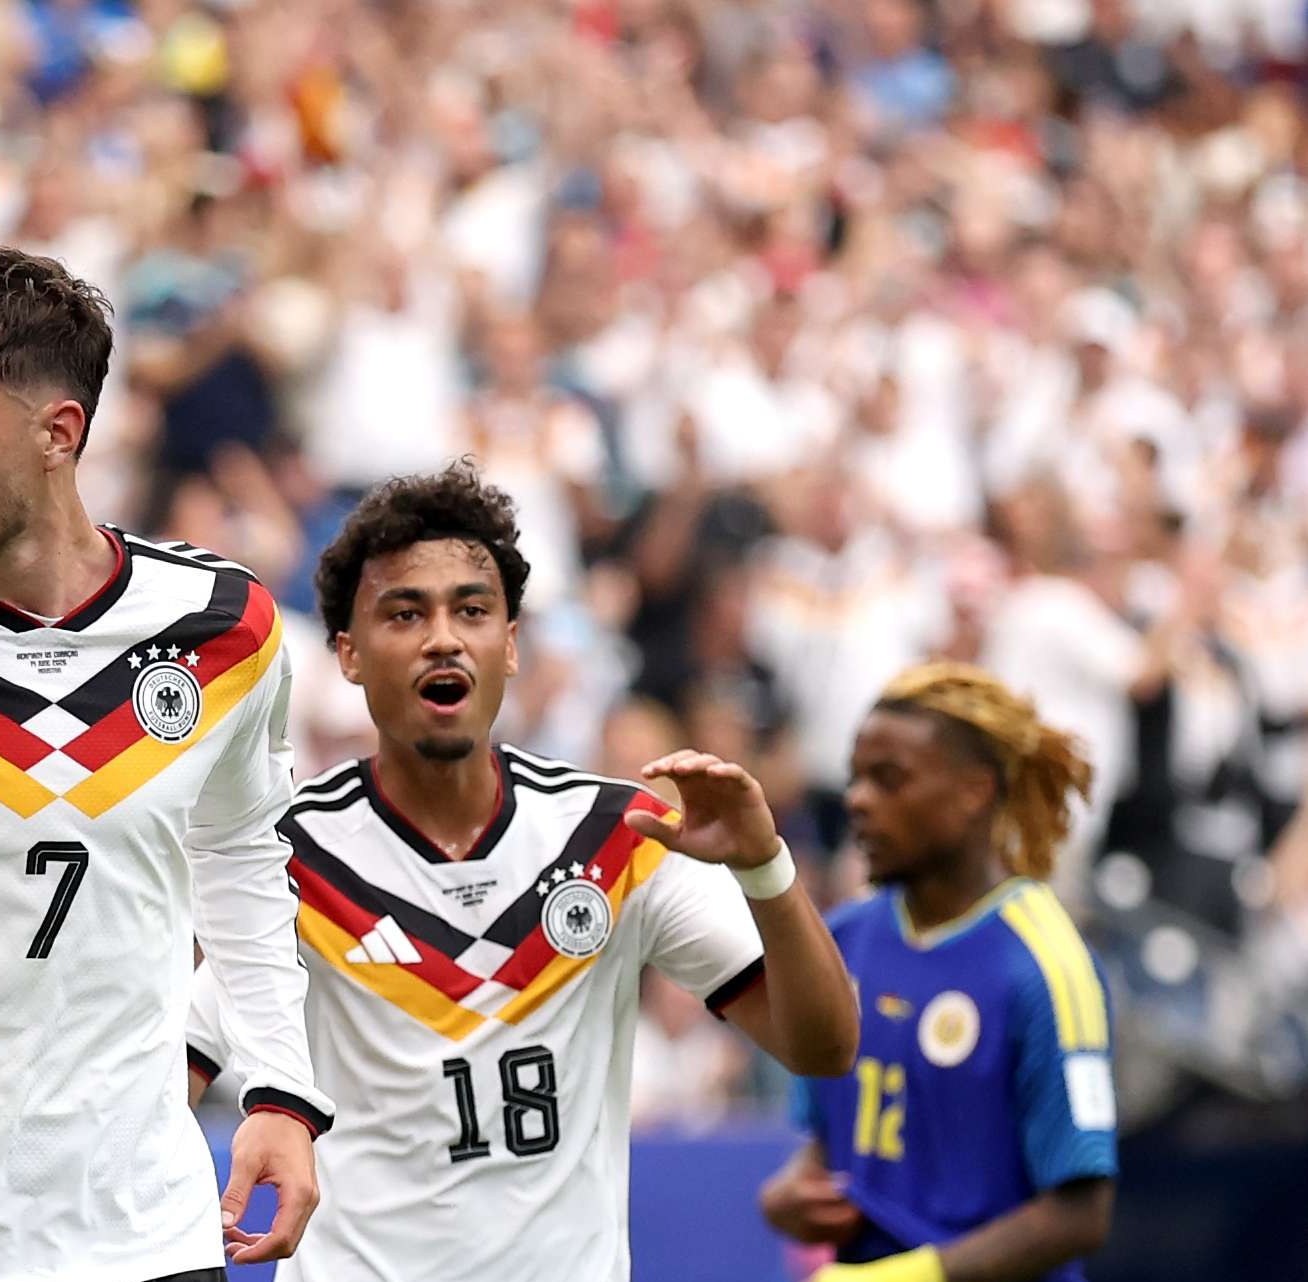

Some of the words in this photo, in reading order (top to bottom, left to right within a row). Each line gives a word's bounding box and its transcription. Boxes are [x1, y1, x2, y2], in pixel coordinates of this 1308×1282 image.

[25, 841, 90, 959] 7
[442, 1045, 560, 1163] 18
[853, 1057, 907, 1162] 12
